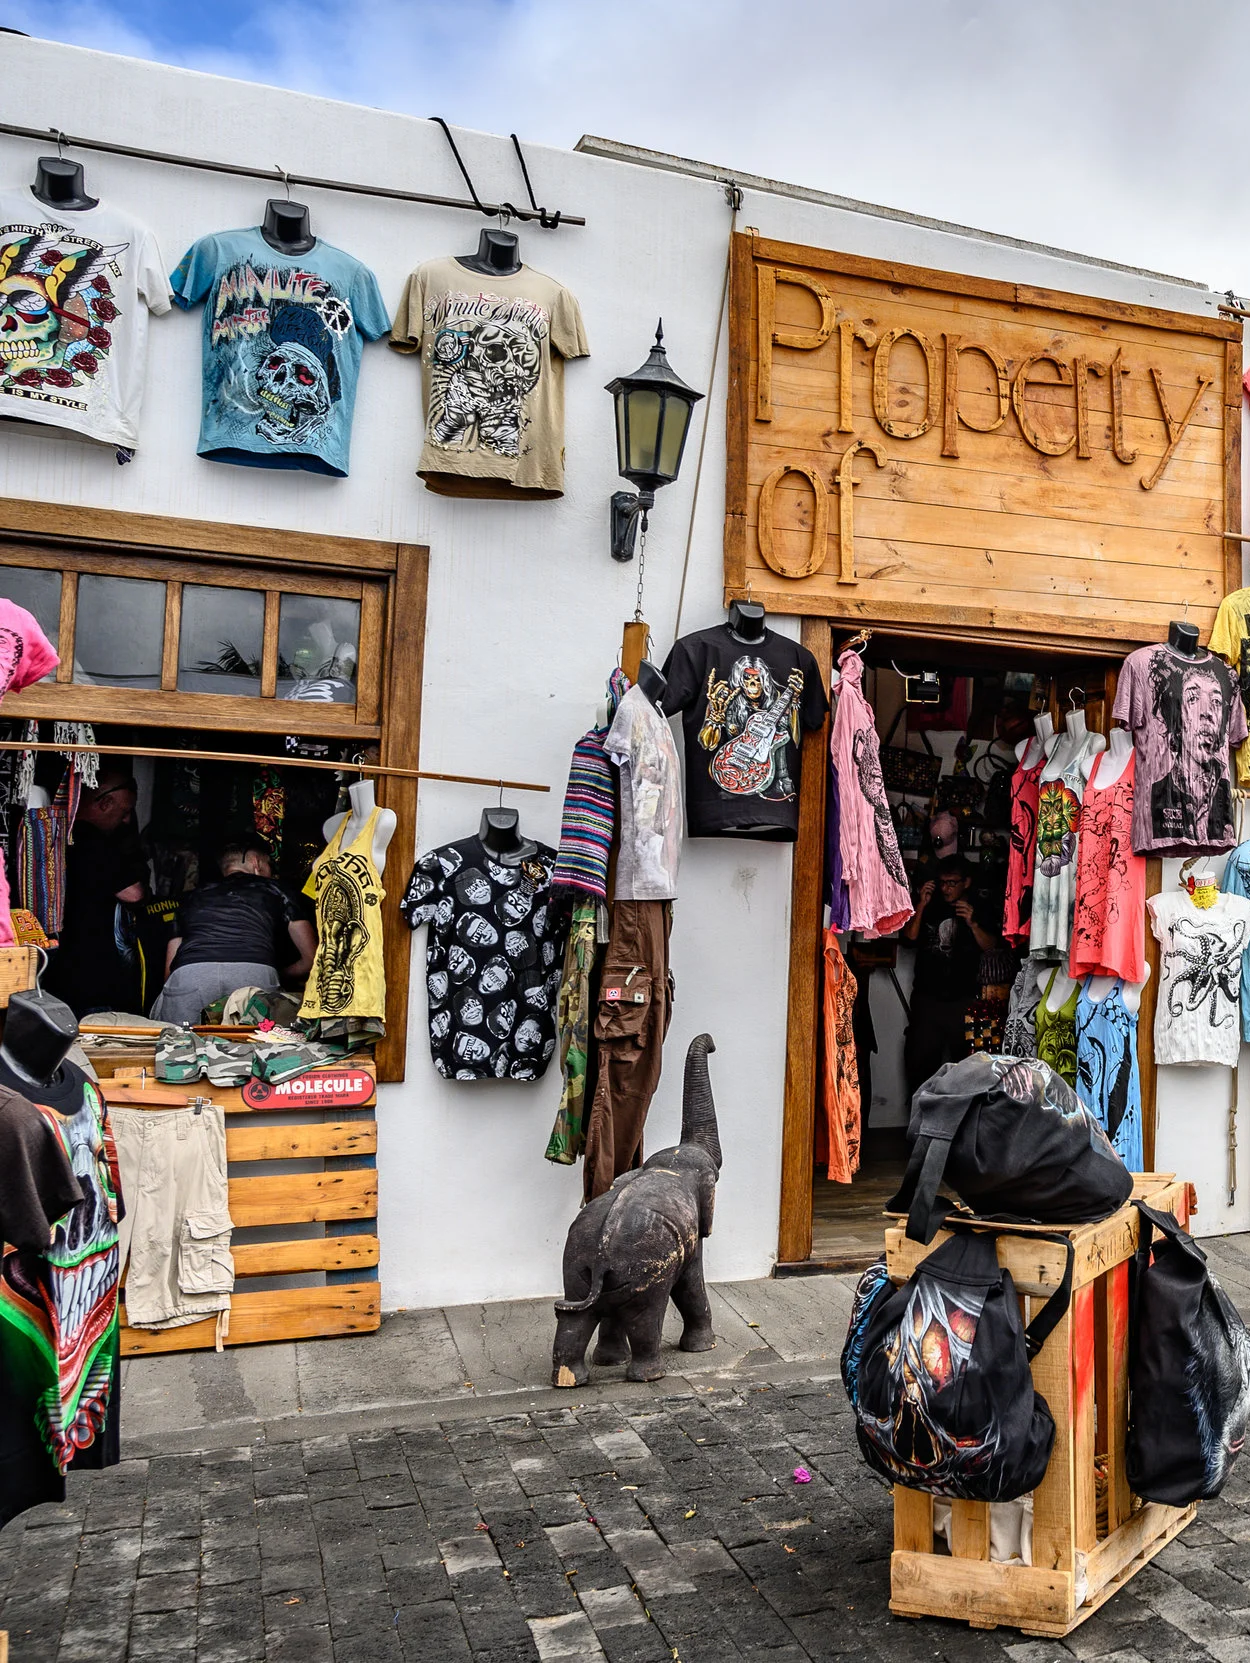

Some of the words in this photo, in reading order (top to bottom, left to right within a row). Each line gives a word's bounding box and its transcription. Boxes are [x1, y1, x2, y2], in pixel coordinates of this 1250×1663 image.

[63, 235, 103, 251] STREET
[215, 262, 330, 319] MINUTE
[755, 264, 1214, 491] Property
[12, 388, 24, 397] IS
[30, 391, 48, 402] MY
[49, 395, 87, 411] STYLE
[758, 439, 888, 586] of
[275, 1078, 363, 1095] MOLECULE
